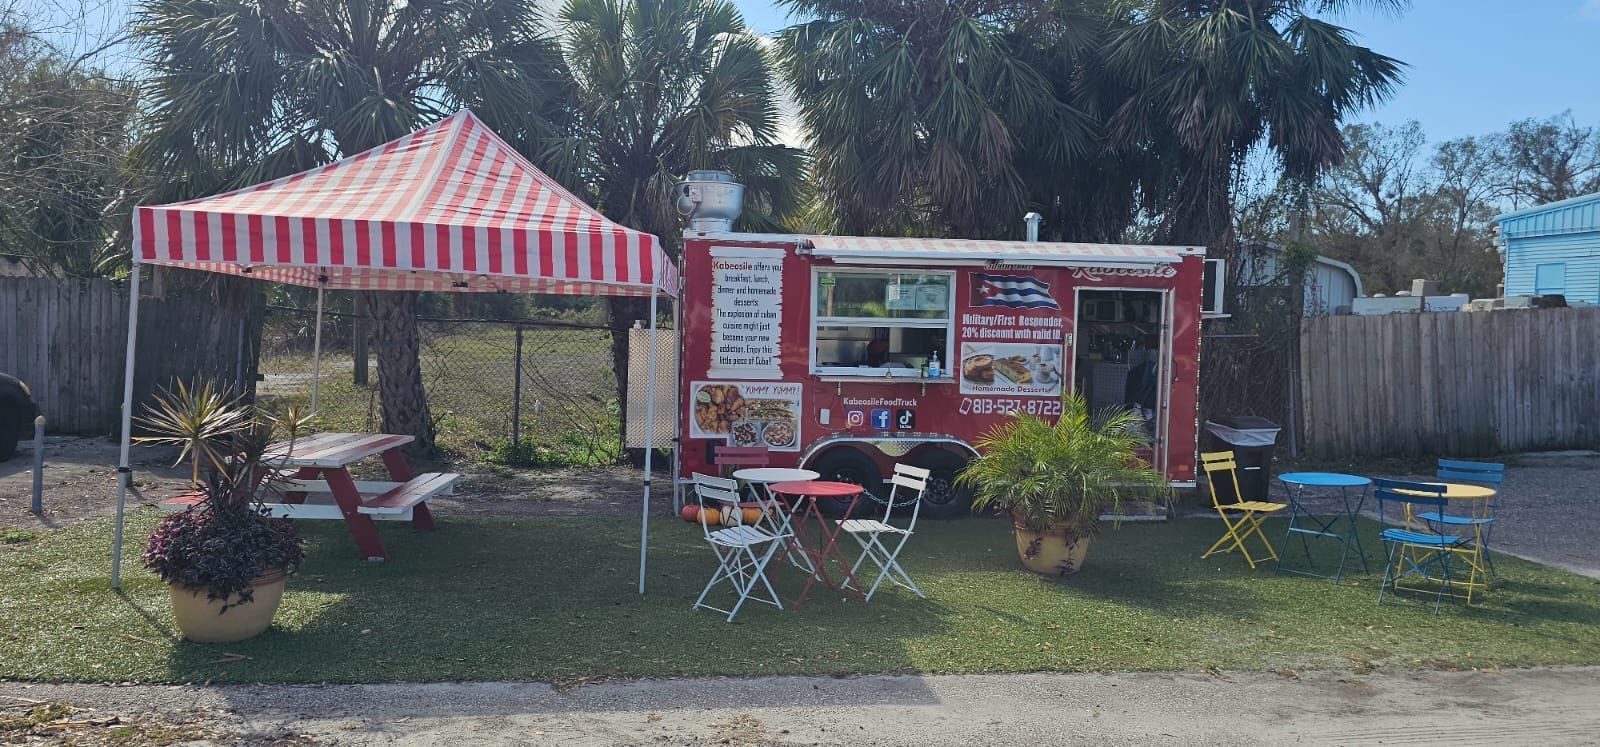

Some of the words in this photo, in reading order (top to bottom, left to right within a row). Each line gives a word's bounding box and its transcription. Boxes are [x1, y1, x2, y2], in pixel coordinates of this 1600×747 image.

[754, 262, 770, 271] offers
[772, 264, 782, 272] you
[718, 286, 735, 294] dinner
[737, 286, 746, 294] and
[748, 286, 776, 295] homemade
[717, 309, 726, 317] The
[727, 310, 753, 319] explosion
[754, 310, 760, 318] of
[761, 310, 777, 318] cuban
[962, 313, 1016, 326] Military/First
[1019, 315, 1063, 328] Responder,
[723, 321, 742, 329] cuisine
[743, 321, 759, 331] might
[760, 322, 770, 331] just
[723, 332, 743, 341] become
[962, 327, 978, 338] 20%
[980, 328, 1013, 339] discount
[1015, 328, 1031, 339] with
[1033, 329, 1051, 340] valid
[720, 344, 746, 353] addiction.
[747, 345, 761, 354] Enjoy
[762, 345, 772, 353] this
[720, 356, 731, 364] little
[733, 357, 747, 366] piece
[745, 385, 769, 395] YUMMY
